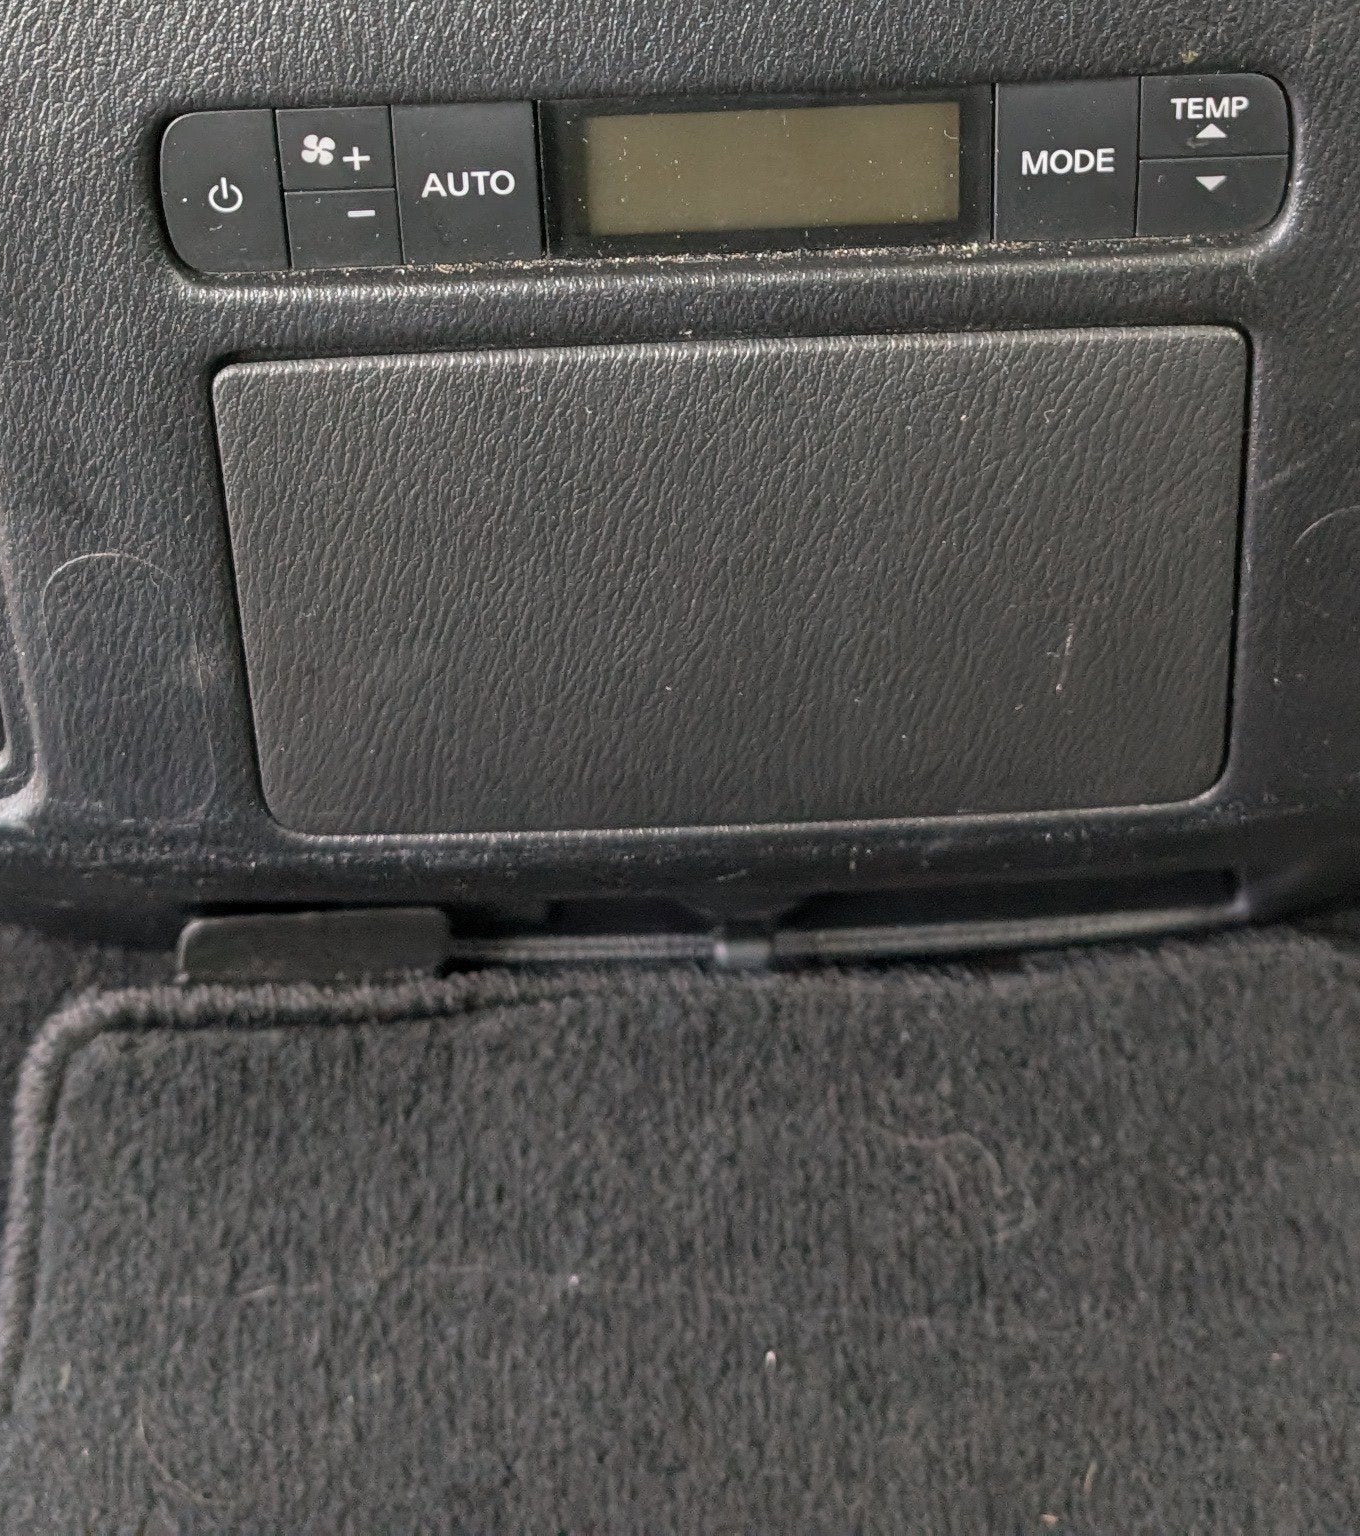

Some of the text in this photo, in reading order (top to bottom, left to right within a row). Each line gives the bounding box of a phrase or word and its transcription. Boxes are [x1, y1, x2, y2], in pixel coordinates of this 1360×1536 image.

[1171, 96, 1249, 120] TEMP
[1022, 148, 1115, 175] MODE
[422, 170, 515, 198] AUTO
